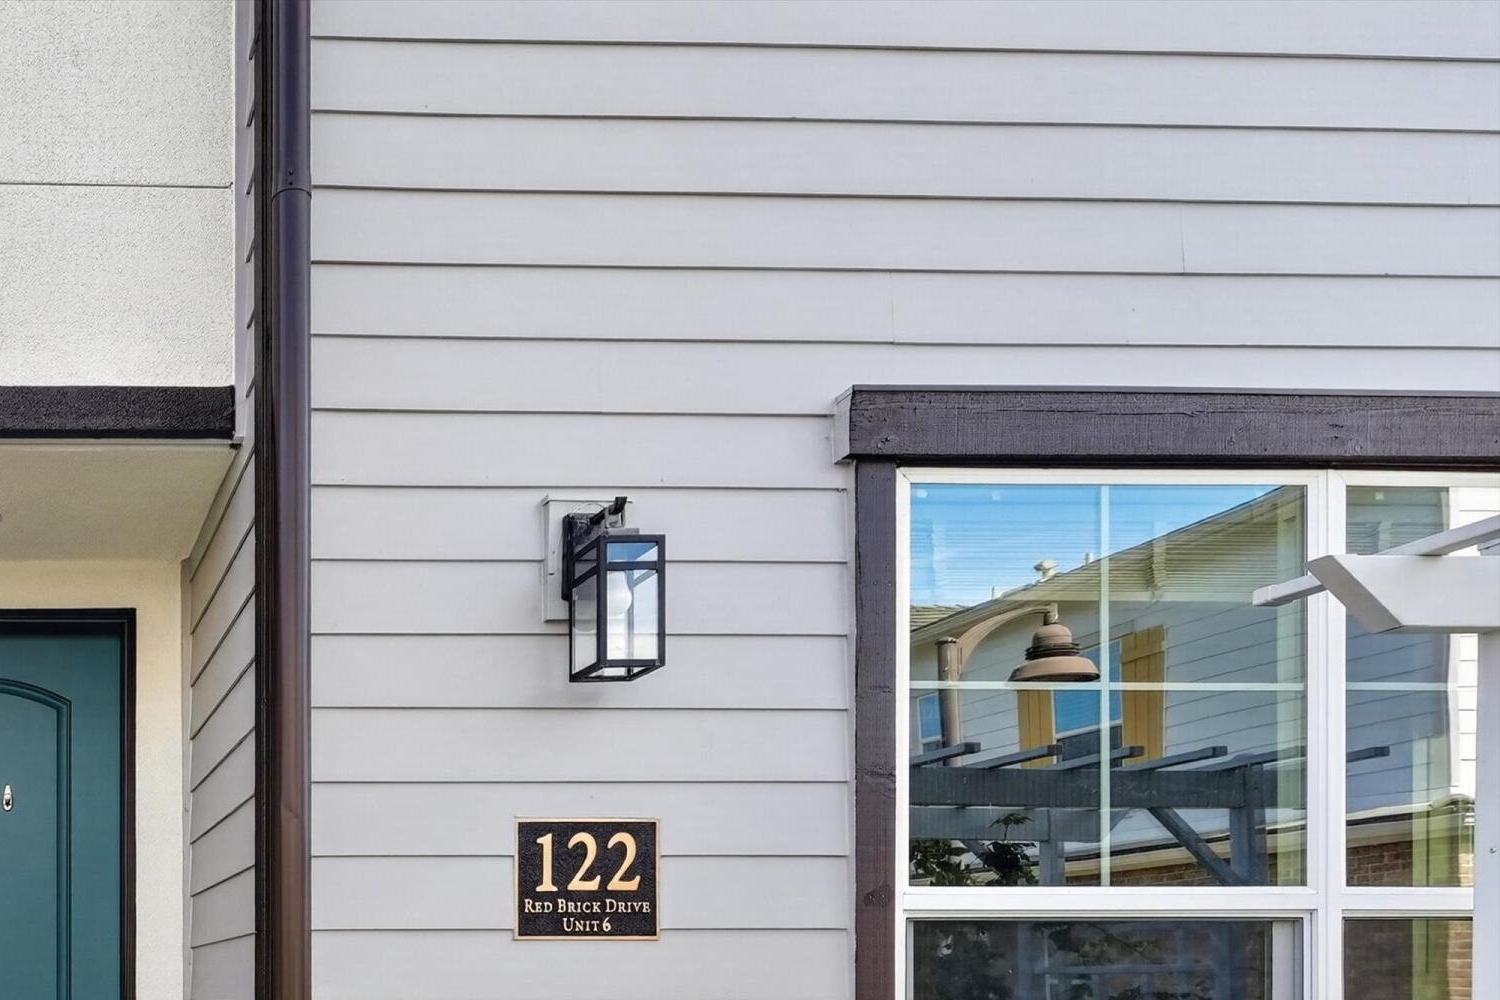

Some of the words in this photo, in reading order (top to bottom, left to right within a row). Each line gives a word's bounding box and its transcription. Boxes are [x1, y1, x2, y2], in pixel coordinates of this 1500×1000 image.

[536, 832, 641, 892] 122
[524, 899, 553, 913] RED
[557, 899, 601, 913] BRICK
[605, 899, 651, 913] DRIVE
[563, 917, 600, 932] UNIT
[602, 917, 612, 932] 6
